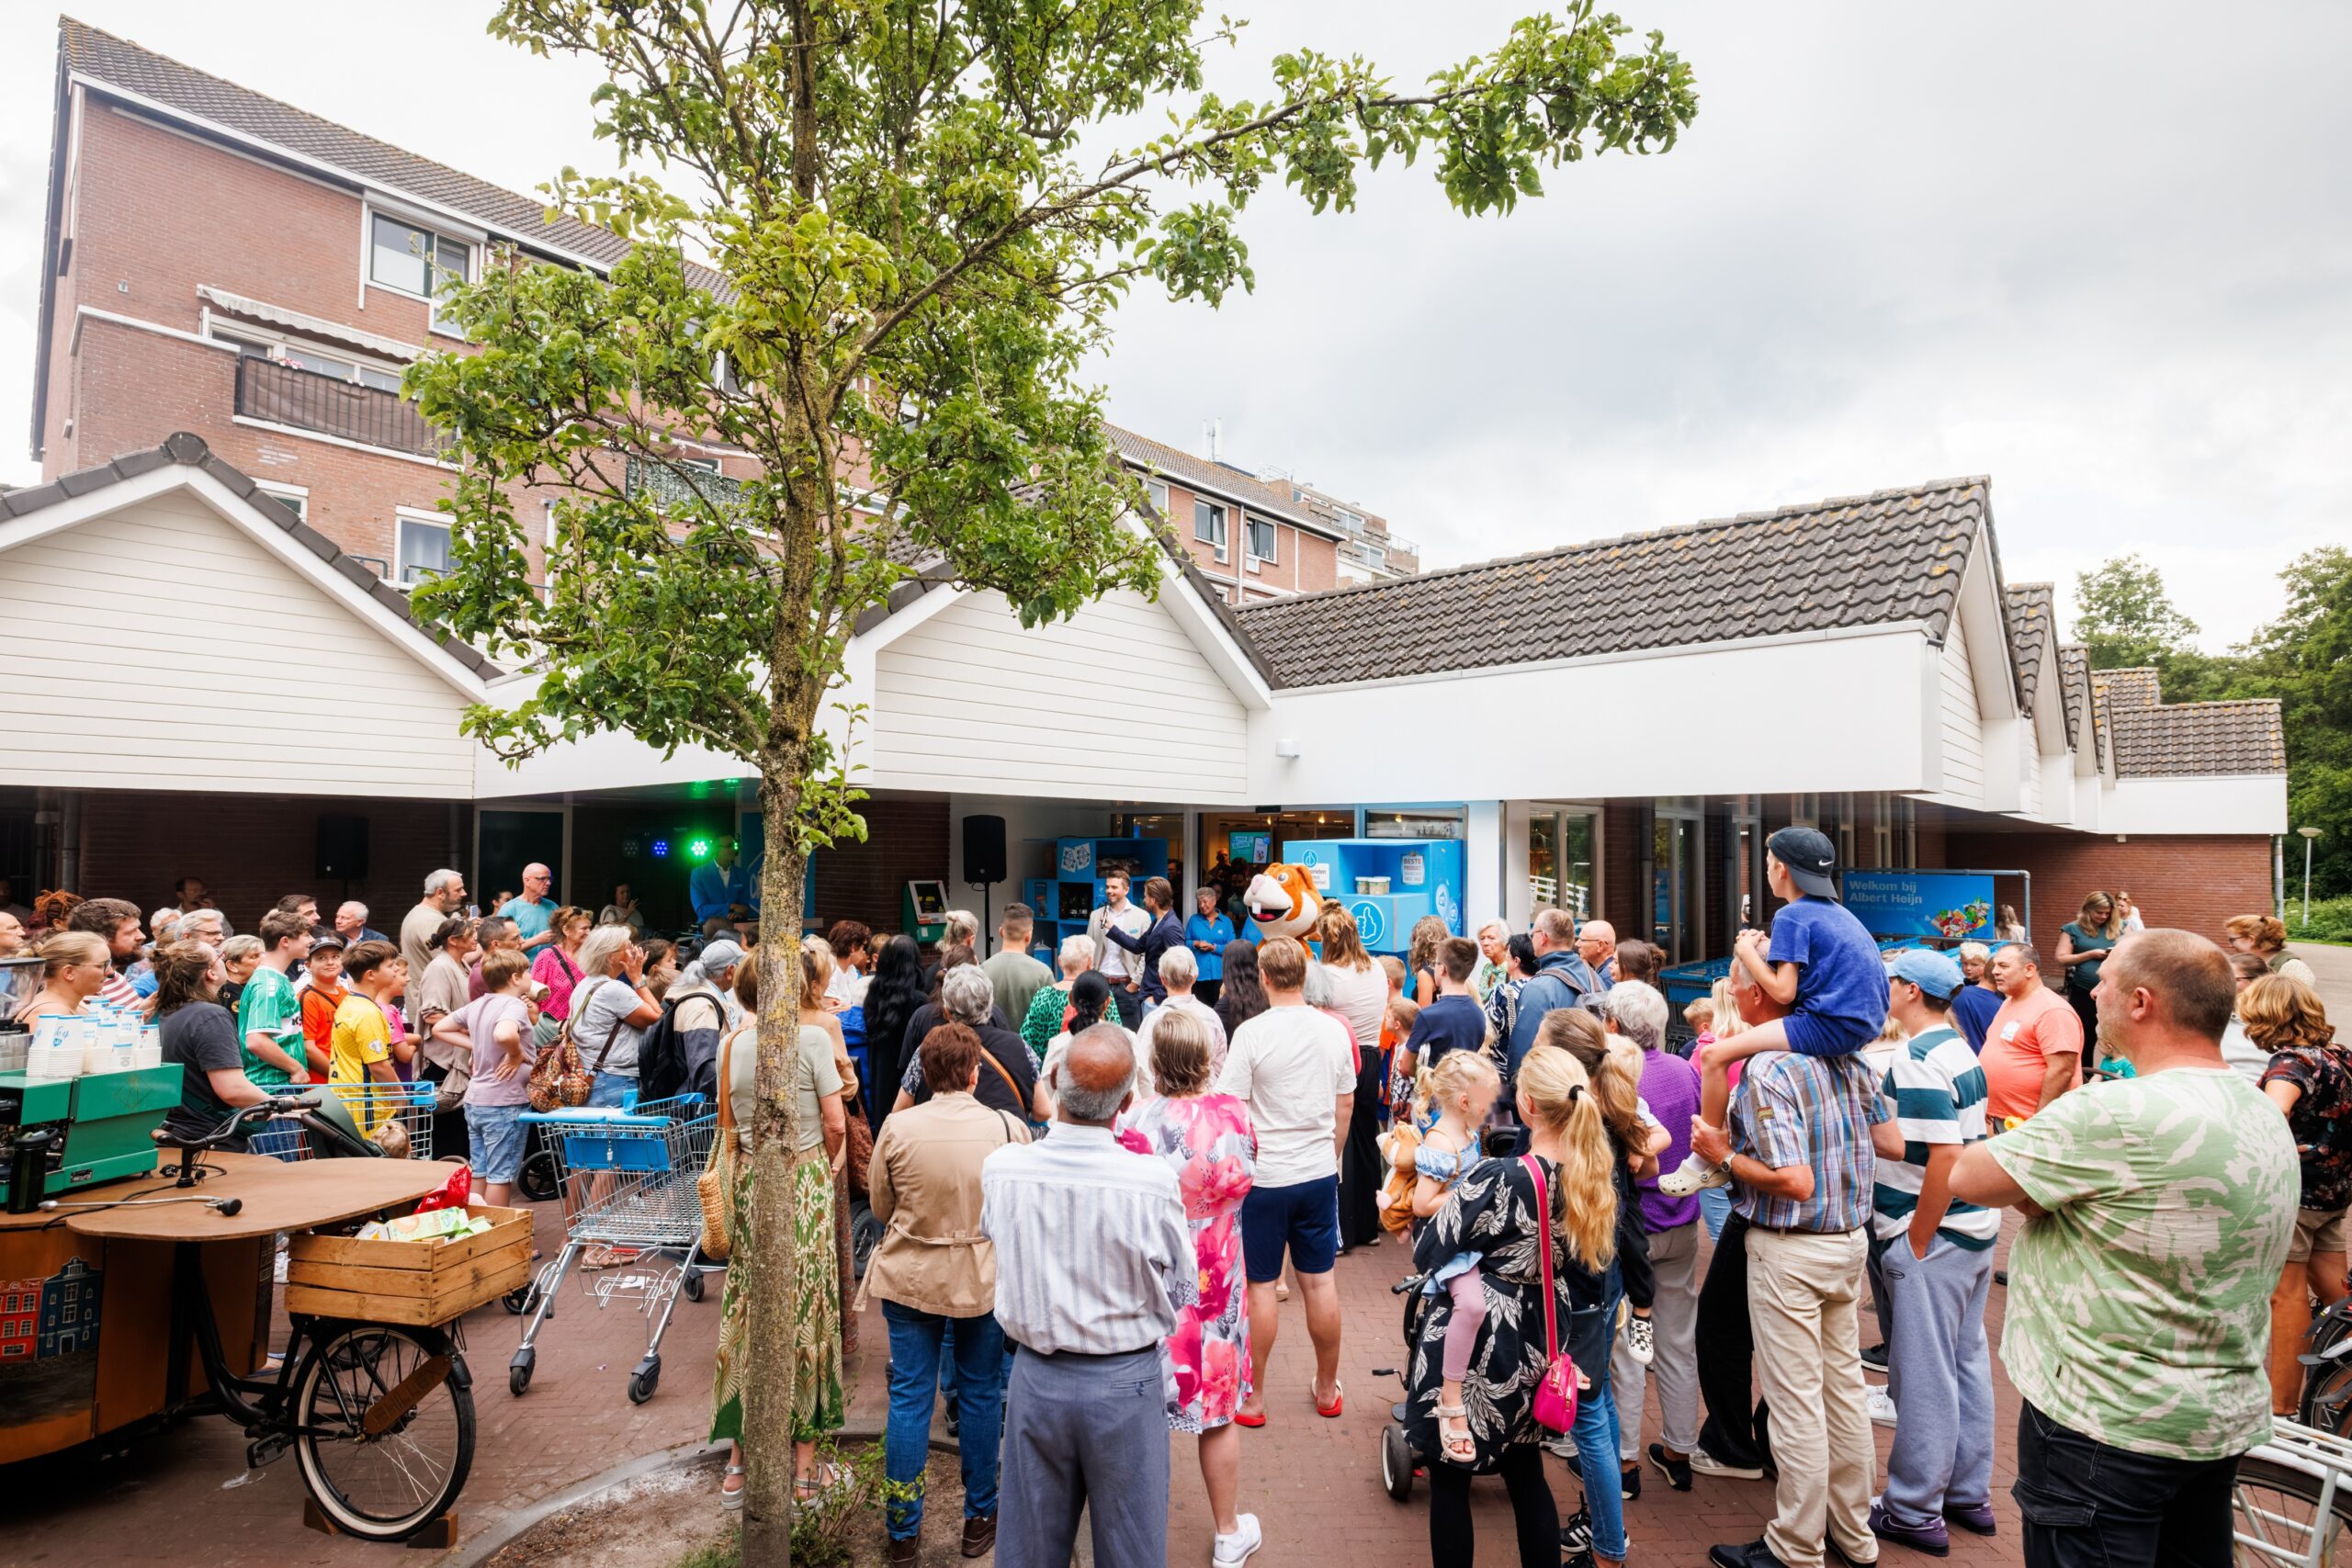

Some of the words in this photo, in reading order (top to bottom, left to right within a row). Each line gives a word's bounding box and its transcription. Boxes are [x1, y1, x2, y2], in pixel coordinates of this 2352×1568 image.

[1849, 881, 1897, 891] Welkom
[1902, 882, 1917, 893] bij
[1849, 893, 1887, 903] Albert
[1891, 894, 1923, 906] Heijn
